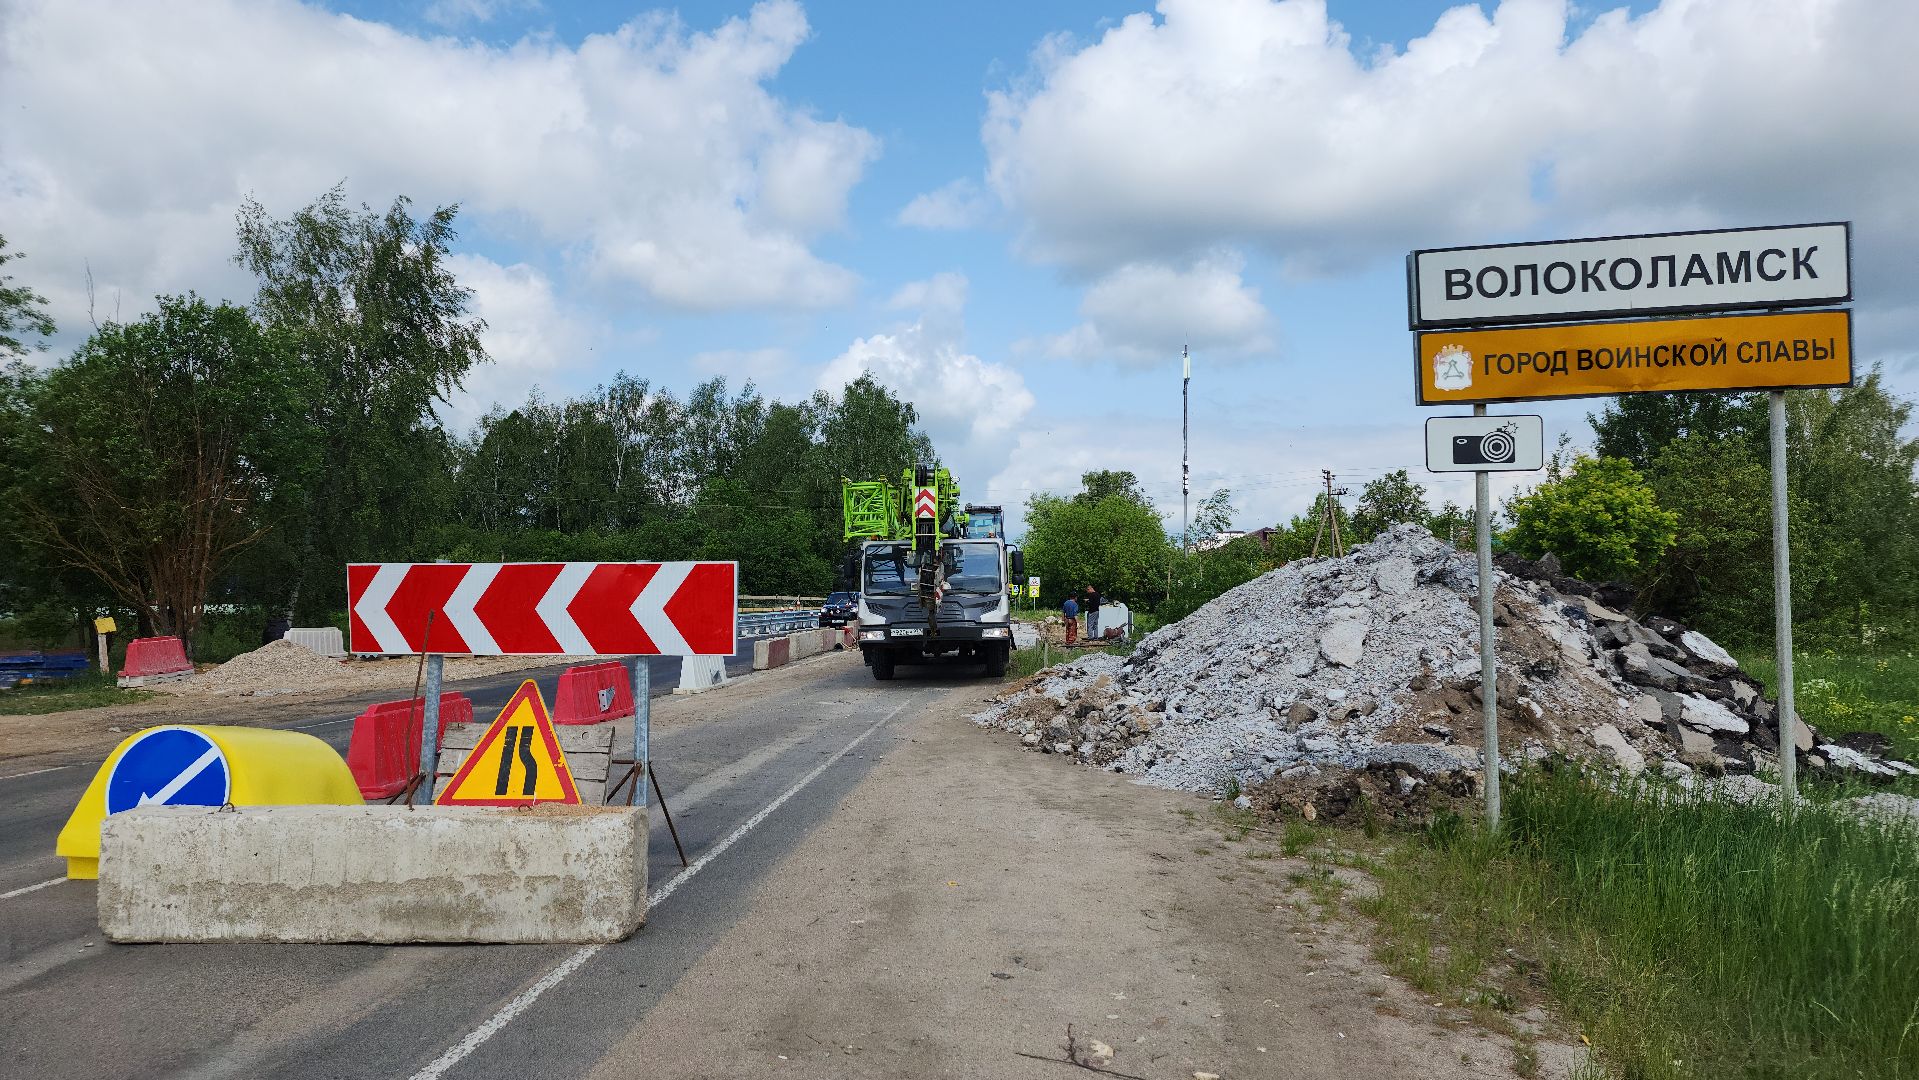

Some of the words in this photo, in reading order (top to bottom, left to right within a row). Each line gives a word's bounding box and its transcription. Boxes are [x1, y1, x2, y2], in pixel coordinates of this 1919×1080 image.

[1445, 246, 1819, 301] ВОЛОКОЛАМСК
[1484, 350, 1568, 376] ГОРОД
[1577, 337, 1727, 371] ВОИНСКОЙ
[1736, 337, 1835, 365] СЛАВЫ
